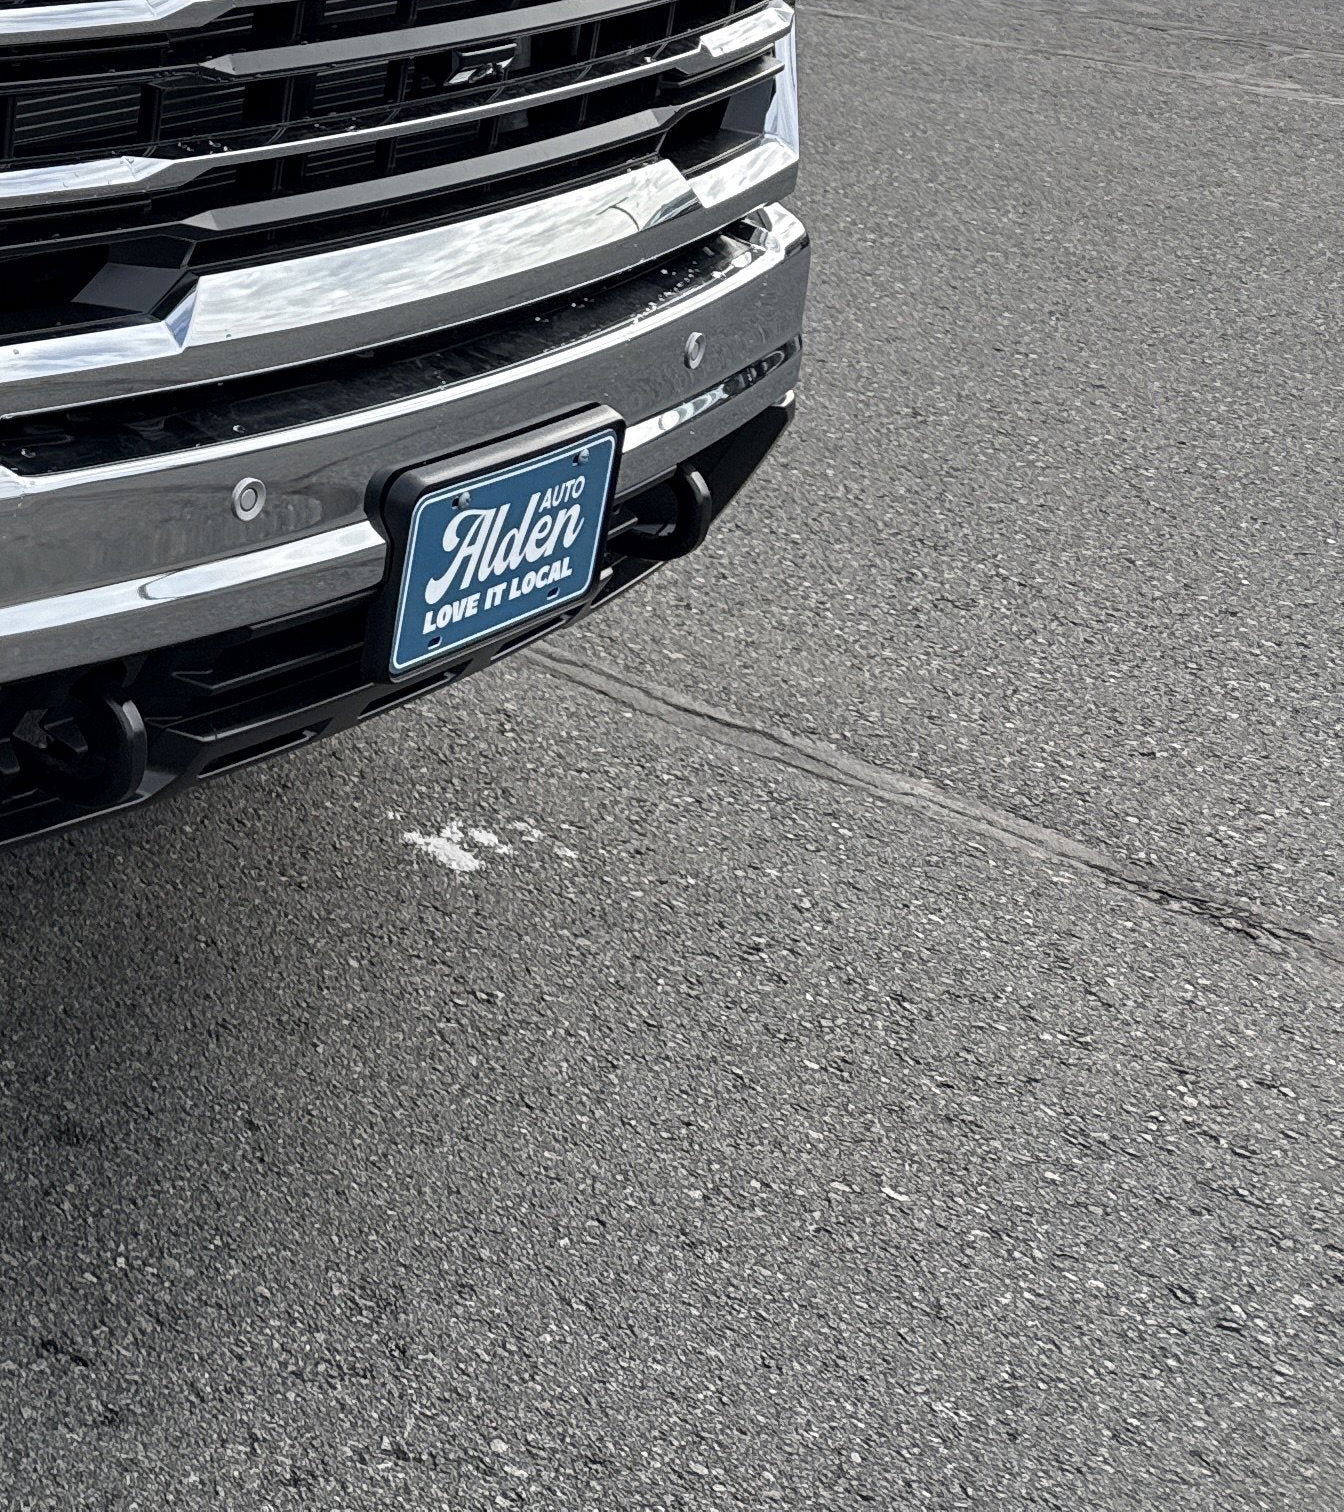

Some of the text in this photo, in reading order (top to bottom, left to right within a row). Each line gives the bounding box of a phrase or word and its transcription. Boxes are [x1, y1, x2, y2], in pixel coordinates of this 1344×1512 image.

[539, 476, 586, 512] AUTO
[424, 493, 585, 605] Alden
[422, 557, 573, 634] LOVE IT LOCAL
